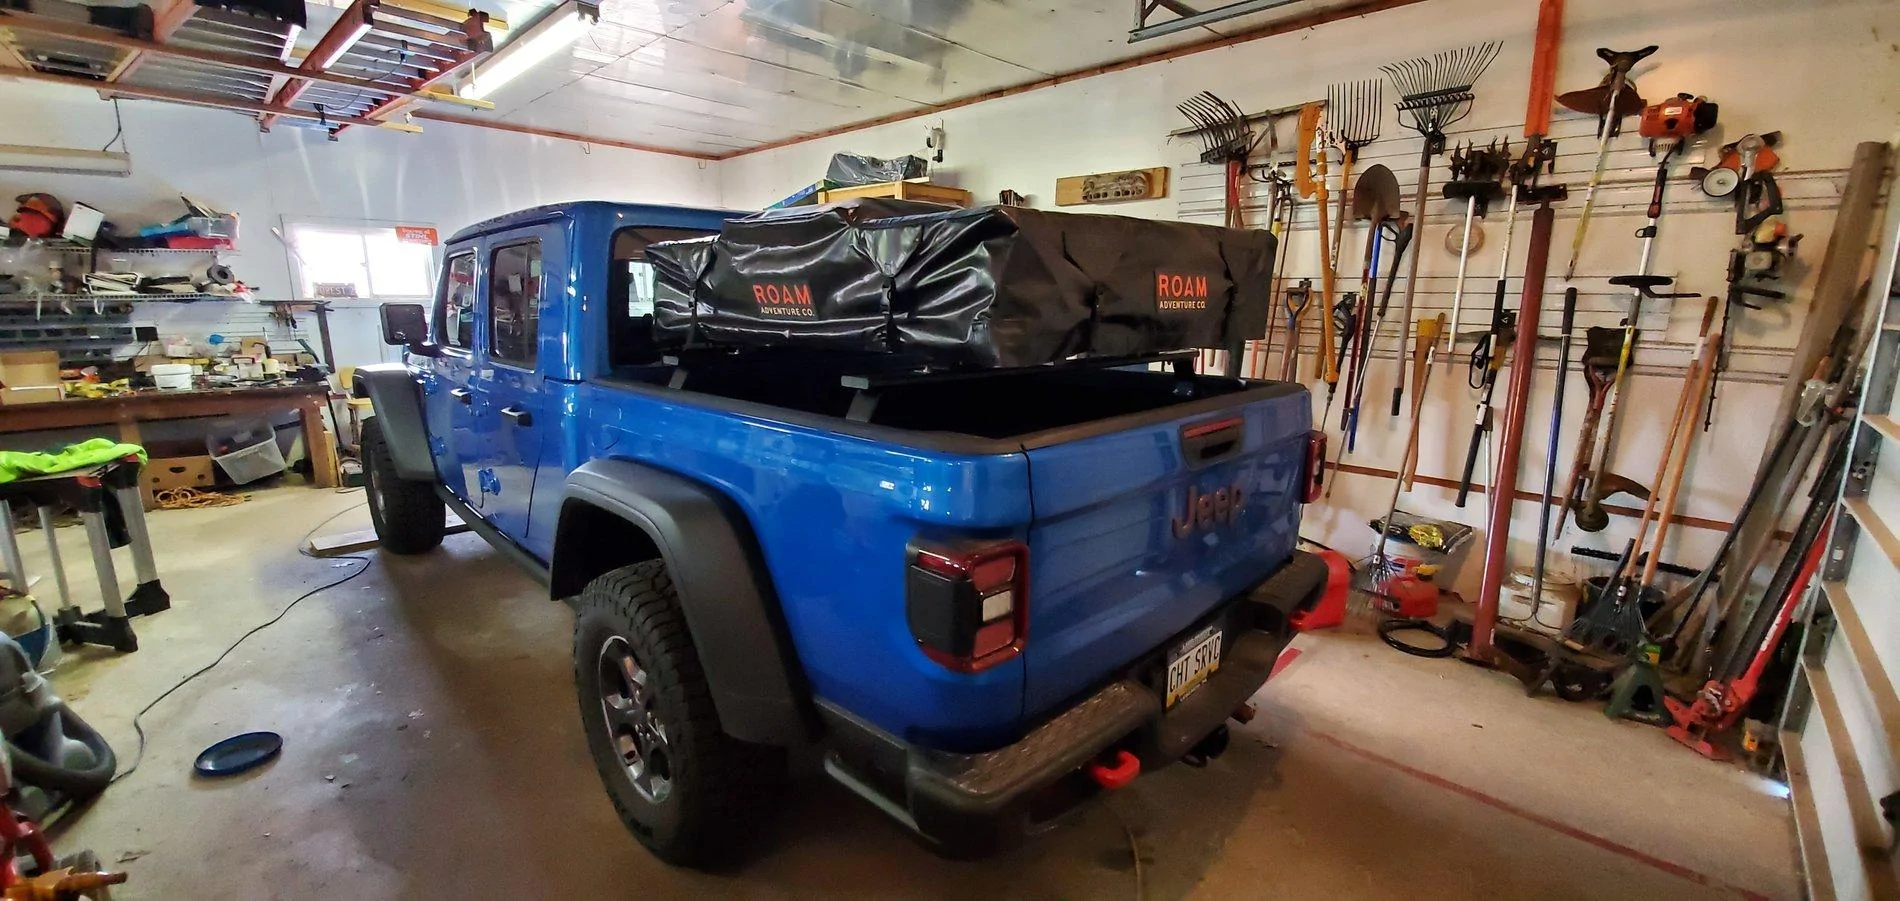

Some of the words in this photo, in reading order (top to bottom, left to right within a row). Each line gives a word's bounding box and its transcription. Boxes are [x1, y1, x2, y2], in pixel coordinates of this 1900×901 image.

[752, 284, 811, 305] ROAM
[1158, 274, 1207, 297] ROAM
[760, 306, 801, 316] ADVENTURE
[801, 308, 815, 317] CO.
[1159, 300, 1196, 309] ADVENTURE
[1172, 484, 1243, 538] Jeep
[1170, 655, 1190, 692] CHT
[1194, 635, 1220, 675] SRVC
